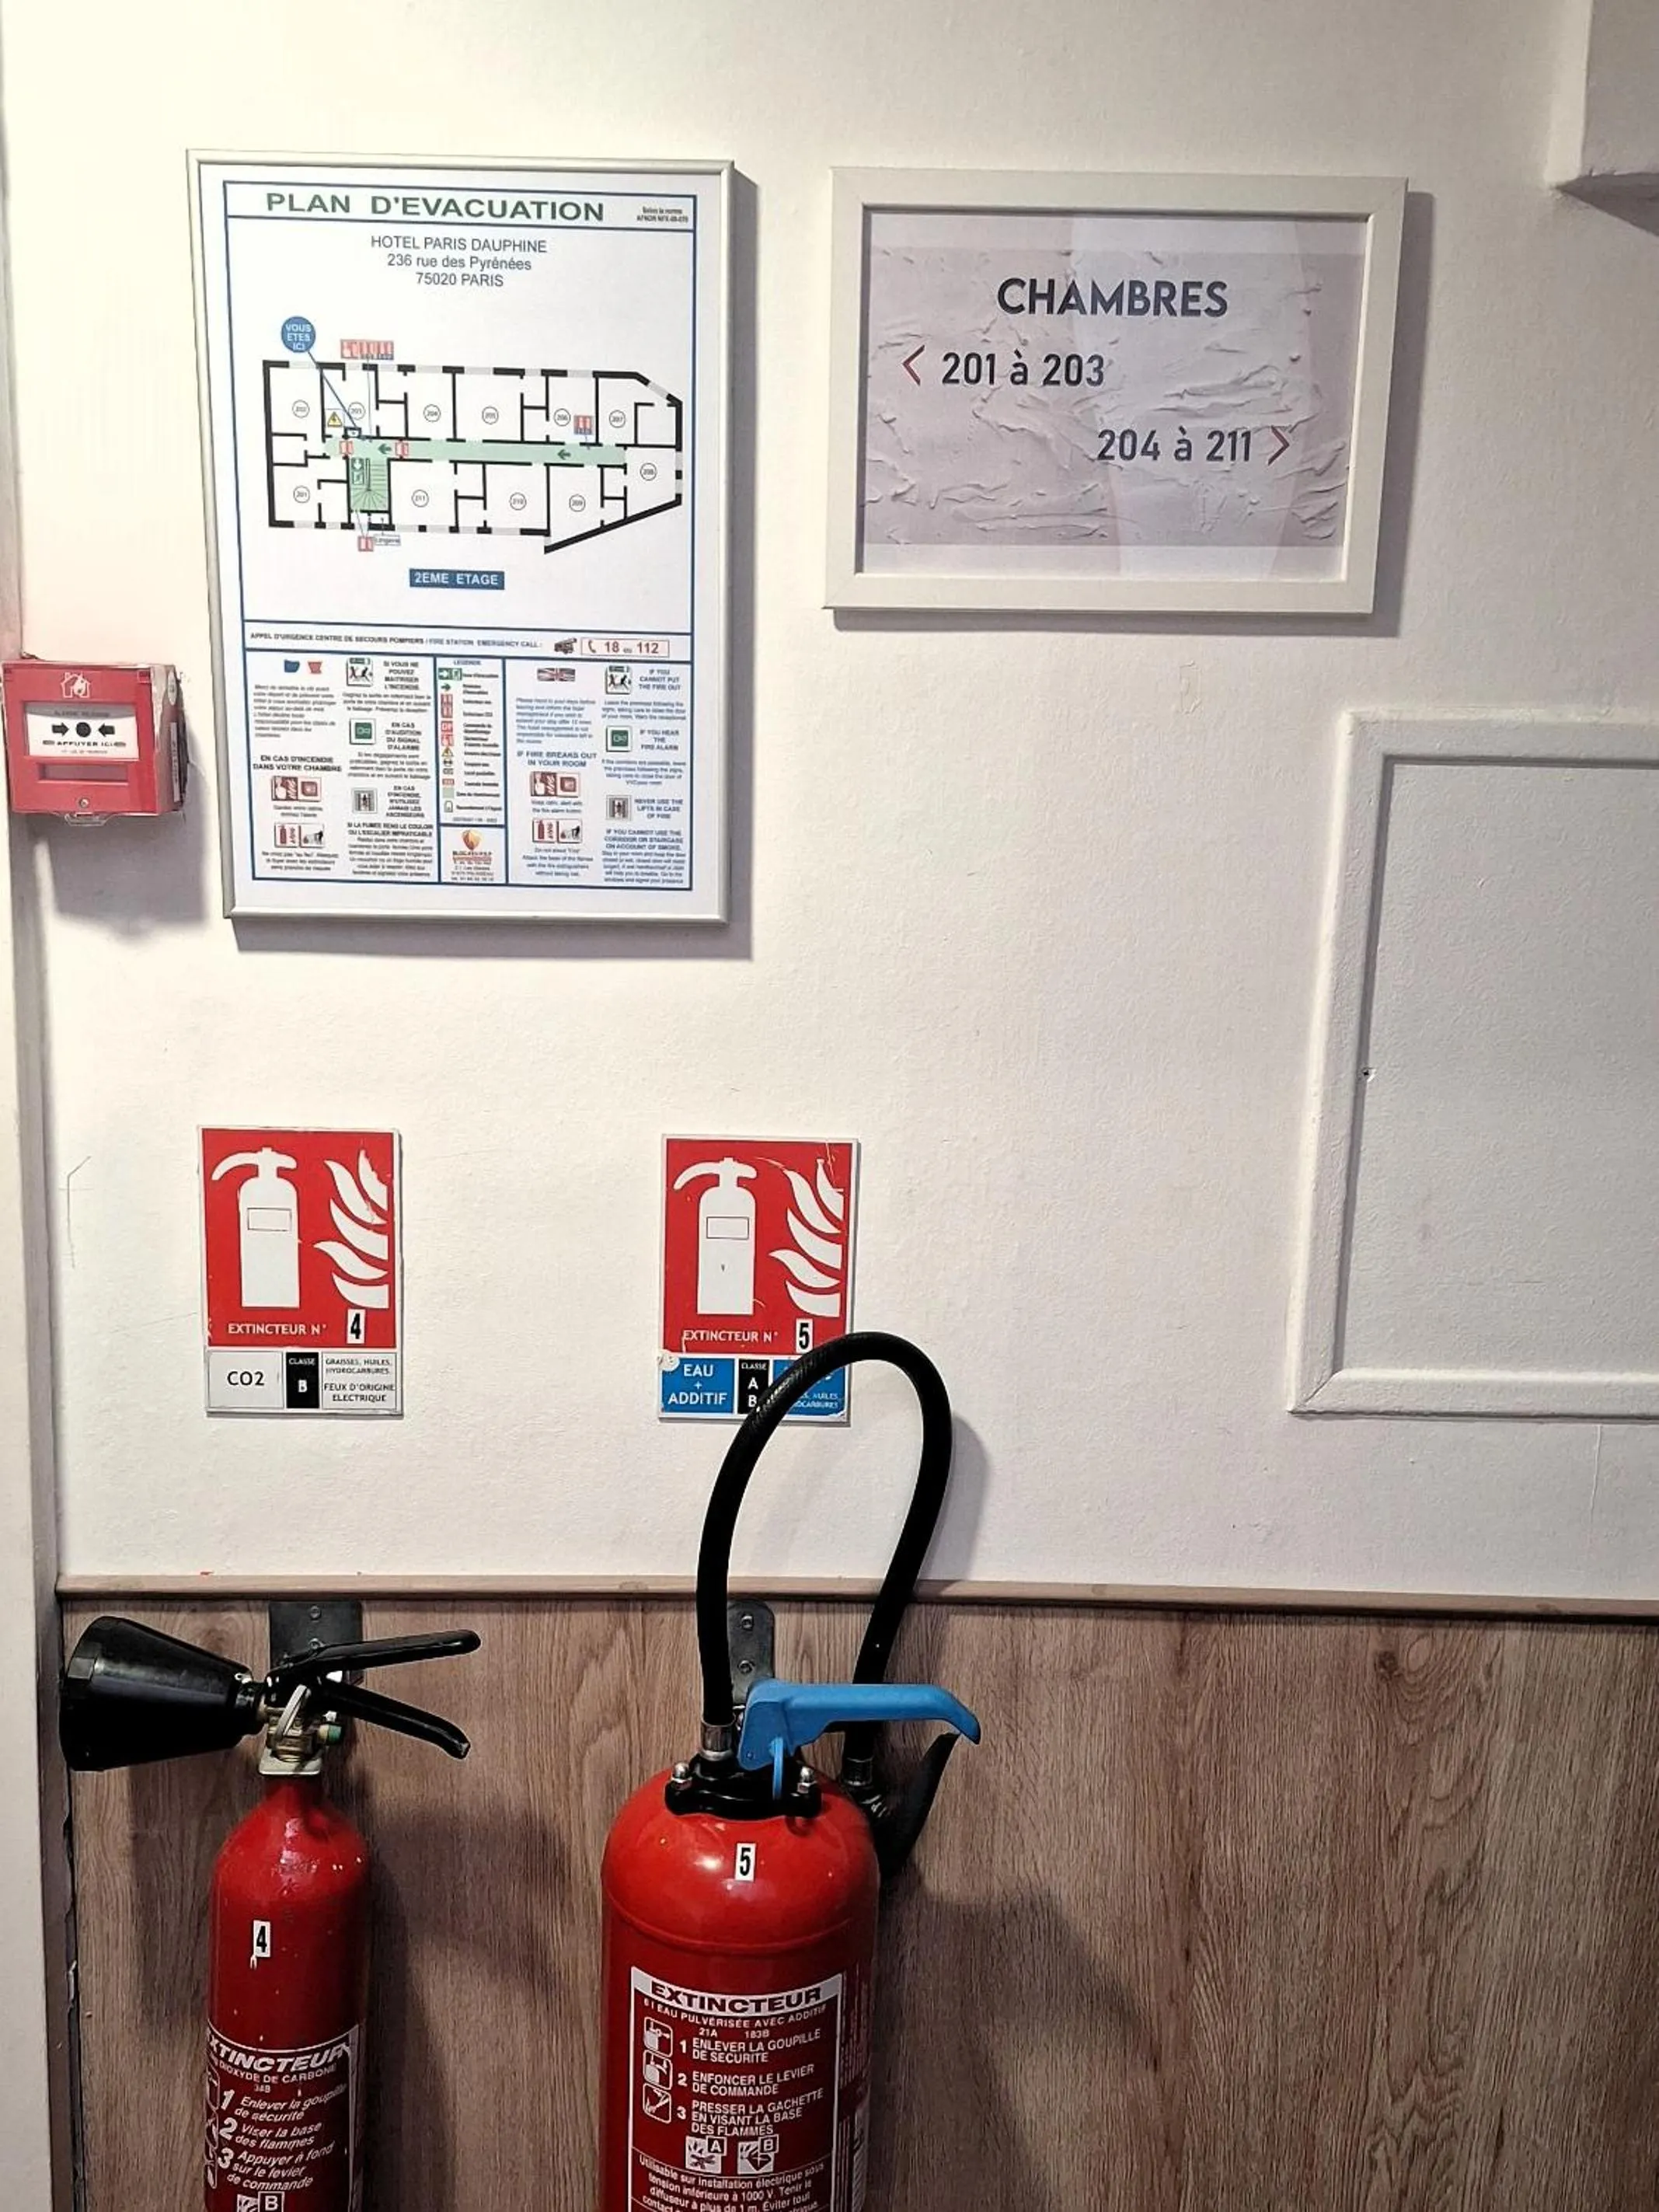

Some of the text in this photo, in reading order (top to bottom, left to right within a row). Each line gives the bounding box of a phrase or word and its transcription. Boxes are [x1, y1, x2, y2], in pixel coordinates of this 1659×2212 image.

[267, 192, 604, 222] PLAN D'EVACUATION
[371, 236, 547, 253] HOTEL PARIS DAUPHINE
[387, 253, 532, 272] 236 rue des Pyrénées
[416, 272, 504, 287] 75020 PARIS
[997, 277, 1228, 318] CHAMBRES
[285, 323, 312, 333] VOUS
[287, 333, 311, 342] ETES
[292, 342, 306, 351] ICI
[942, 349, 1107, 388] 201 à 203
[1097, 425, 1253, 462] 204 à 211
[414, 572, 498, 585] 2EME ETAGE
[605, 640, 620, 653] 18
[636, 641, 659, 654] 112
[228, 1323, 307, 1335] EXTINCTEUR
[350, 1312, 362, 1340] 4
[682, 1329, 758, 1343] EXTINCTEUR
[798, 1322, 811, 1351] 5
[325, 1366, 390, 1375] HYDROCARBURES
[683, 1364, 713, 1377] EAU
[741, 1362, 768, 1371] CLASSE
[227, 1370, 266, 1387] CO2
[298, 1379, 308, 1394] B
[748, 1376, 758, 1390] A
[323, 1383, 396, 1392] FEUX D'ORIGINE
[332, 1394, 387, 1404] ELECTRIQUE
[668, 1391, 728, 1405] ADDITIF
[748, 1394, 758, 1408] B
[739, 1846, 752, 1876] 5
[256, 1924, 268, 1954] 4
[652, 1980, 821, 2014] EXTINCTEUR
[657, 2003, 678, 2018] EAU
[681, 2011, 751, 2029] PULVÉRISÉE
[755, 2016, 786, 2029] AVEC
[788, 2003, 827, 2023] ADDITIF
[692, 2028, 821, 2053] ENLEVER LA GOUPILLE
[699, 2027, 718, 2038] 21A
[679, 2039, 687, 2053] 1
[692, 2050, 769, 2064] DE SECURITE
[218, 2060, 260, 2083] DIOXYDE
[263, 2075, 280, 2085] DE
[678, 2073, 688, 2087] 2
[692, 2064, 815, 2086] ENFONCER LE LEVIER
[692, 2082, 779, 2097] DE COMMANDE
[221, 2088, 235, 2111] 1
[240, 2095, 289, 2111] Enlever
[289, 2099, 301, 2109] la
[692, 2087, 824, 2115] PRESSER LA GACHETTE
[234, 2107, 305, 2123] de sécurité
[677, 2106, 687, 2120] 3
[692, 2107, 803, 2126] EN VISANT LA BASE
[218, 2116, 239, 2141] 2
[242, 2121, 322, 2138] Viser la base
[691, 2123, 774, 2137] DES FLAMMES
[235, 2135, 315, 2151] des flammes
[709, 2142, 722, 2153] A
[763, 2138, 774, 2151] B
[218, 2146, 234, 2169] 3
[237, 2149, 294, 2168] Appuyer
[305, 2140, 336, 2161] fond
[232, 2162, 307, 2179] sur le levier
[639, 2153, 679, 2181] Utilisable
[698, 2175, 753, 2190] installation
[226, 2172, 314, 2191] de commande
[648, 2172, 681, 2194] tension
[741, 2189, 765, 2203] 1000
[779, 2182, 803, 2197] Tenir
[264, 2195, 279, 2211] B
